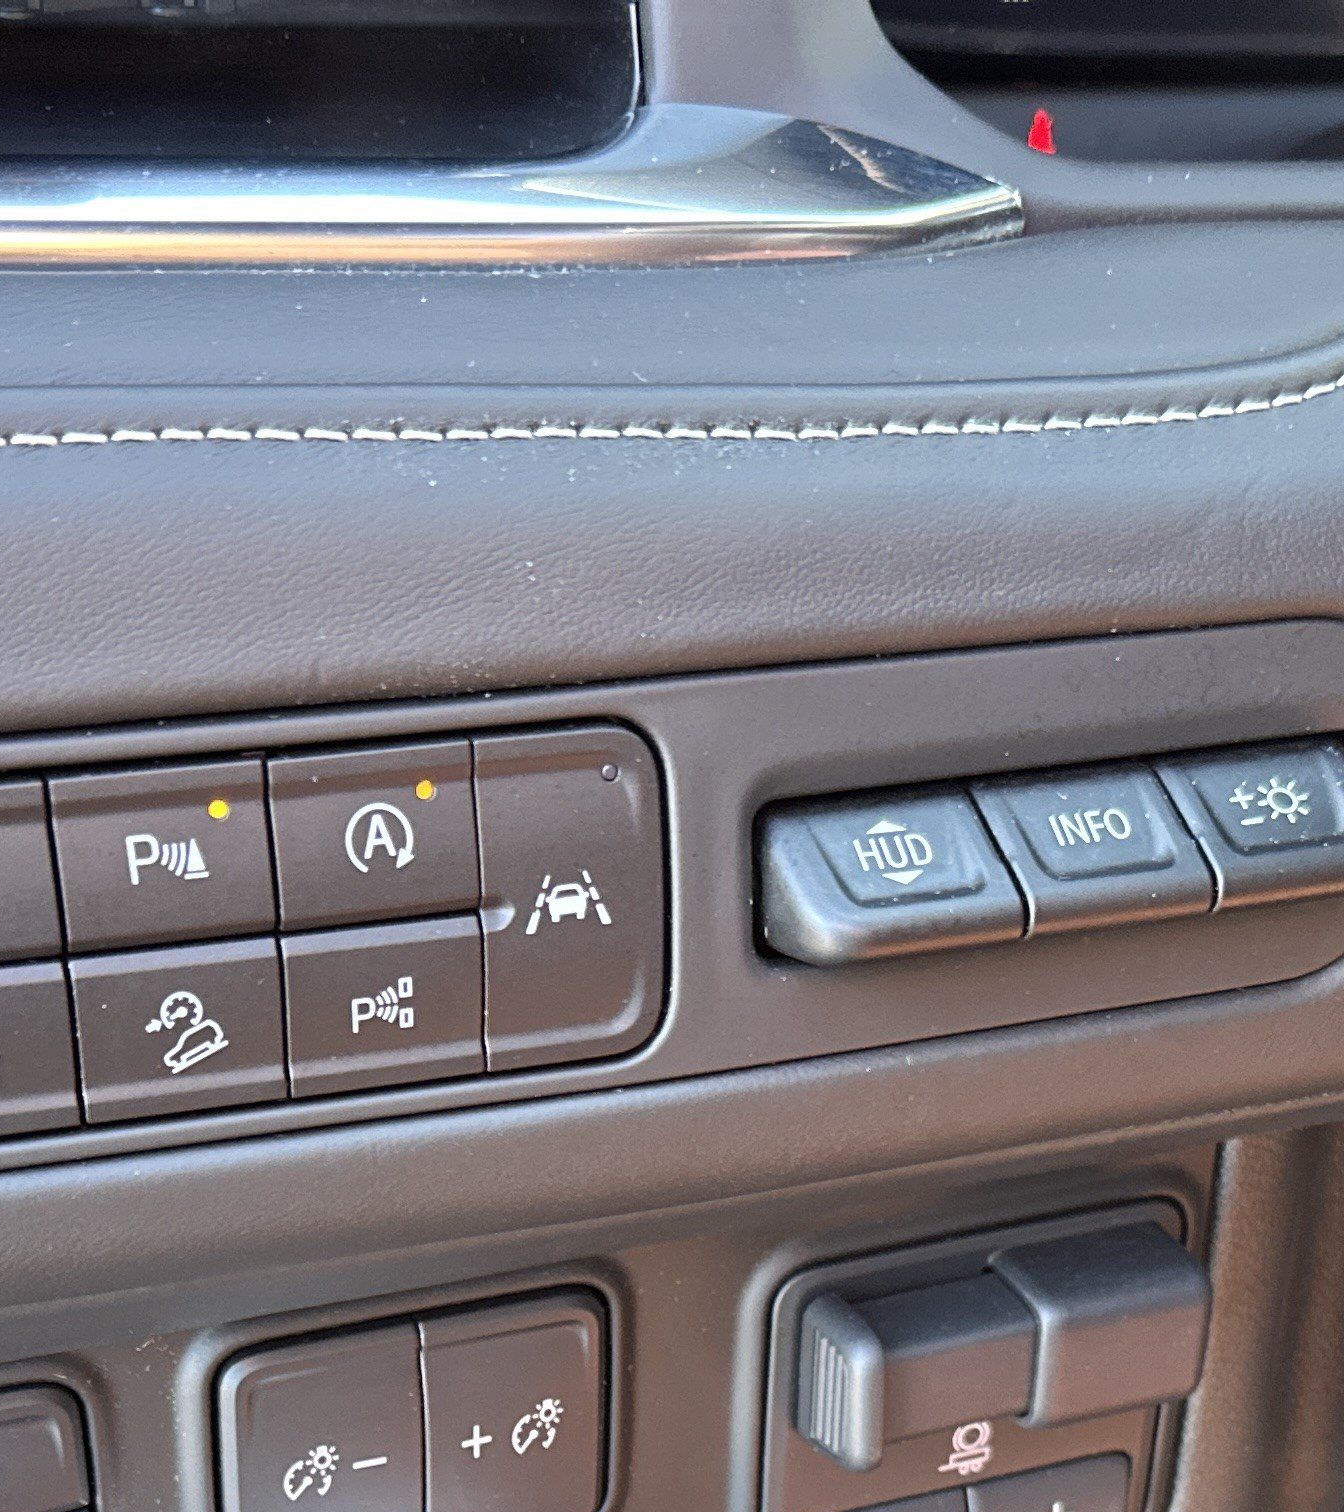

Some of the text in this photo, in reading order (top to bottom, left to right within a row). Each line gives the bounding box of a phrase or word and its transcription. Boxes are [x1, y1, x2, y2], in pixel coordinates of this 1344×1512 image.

[364, 814, 397, 860] A
[1048, 807, 1132, 848] INFO
[125, 834, 159, 885] P
[853, 832, 934, 873] HUD
[351, 997, 376, 1033] P
